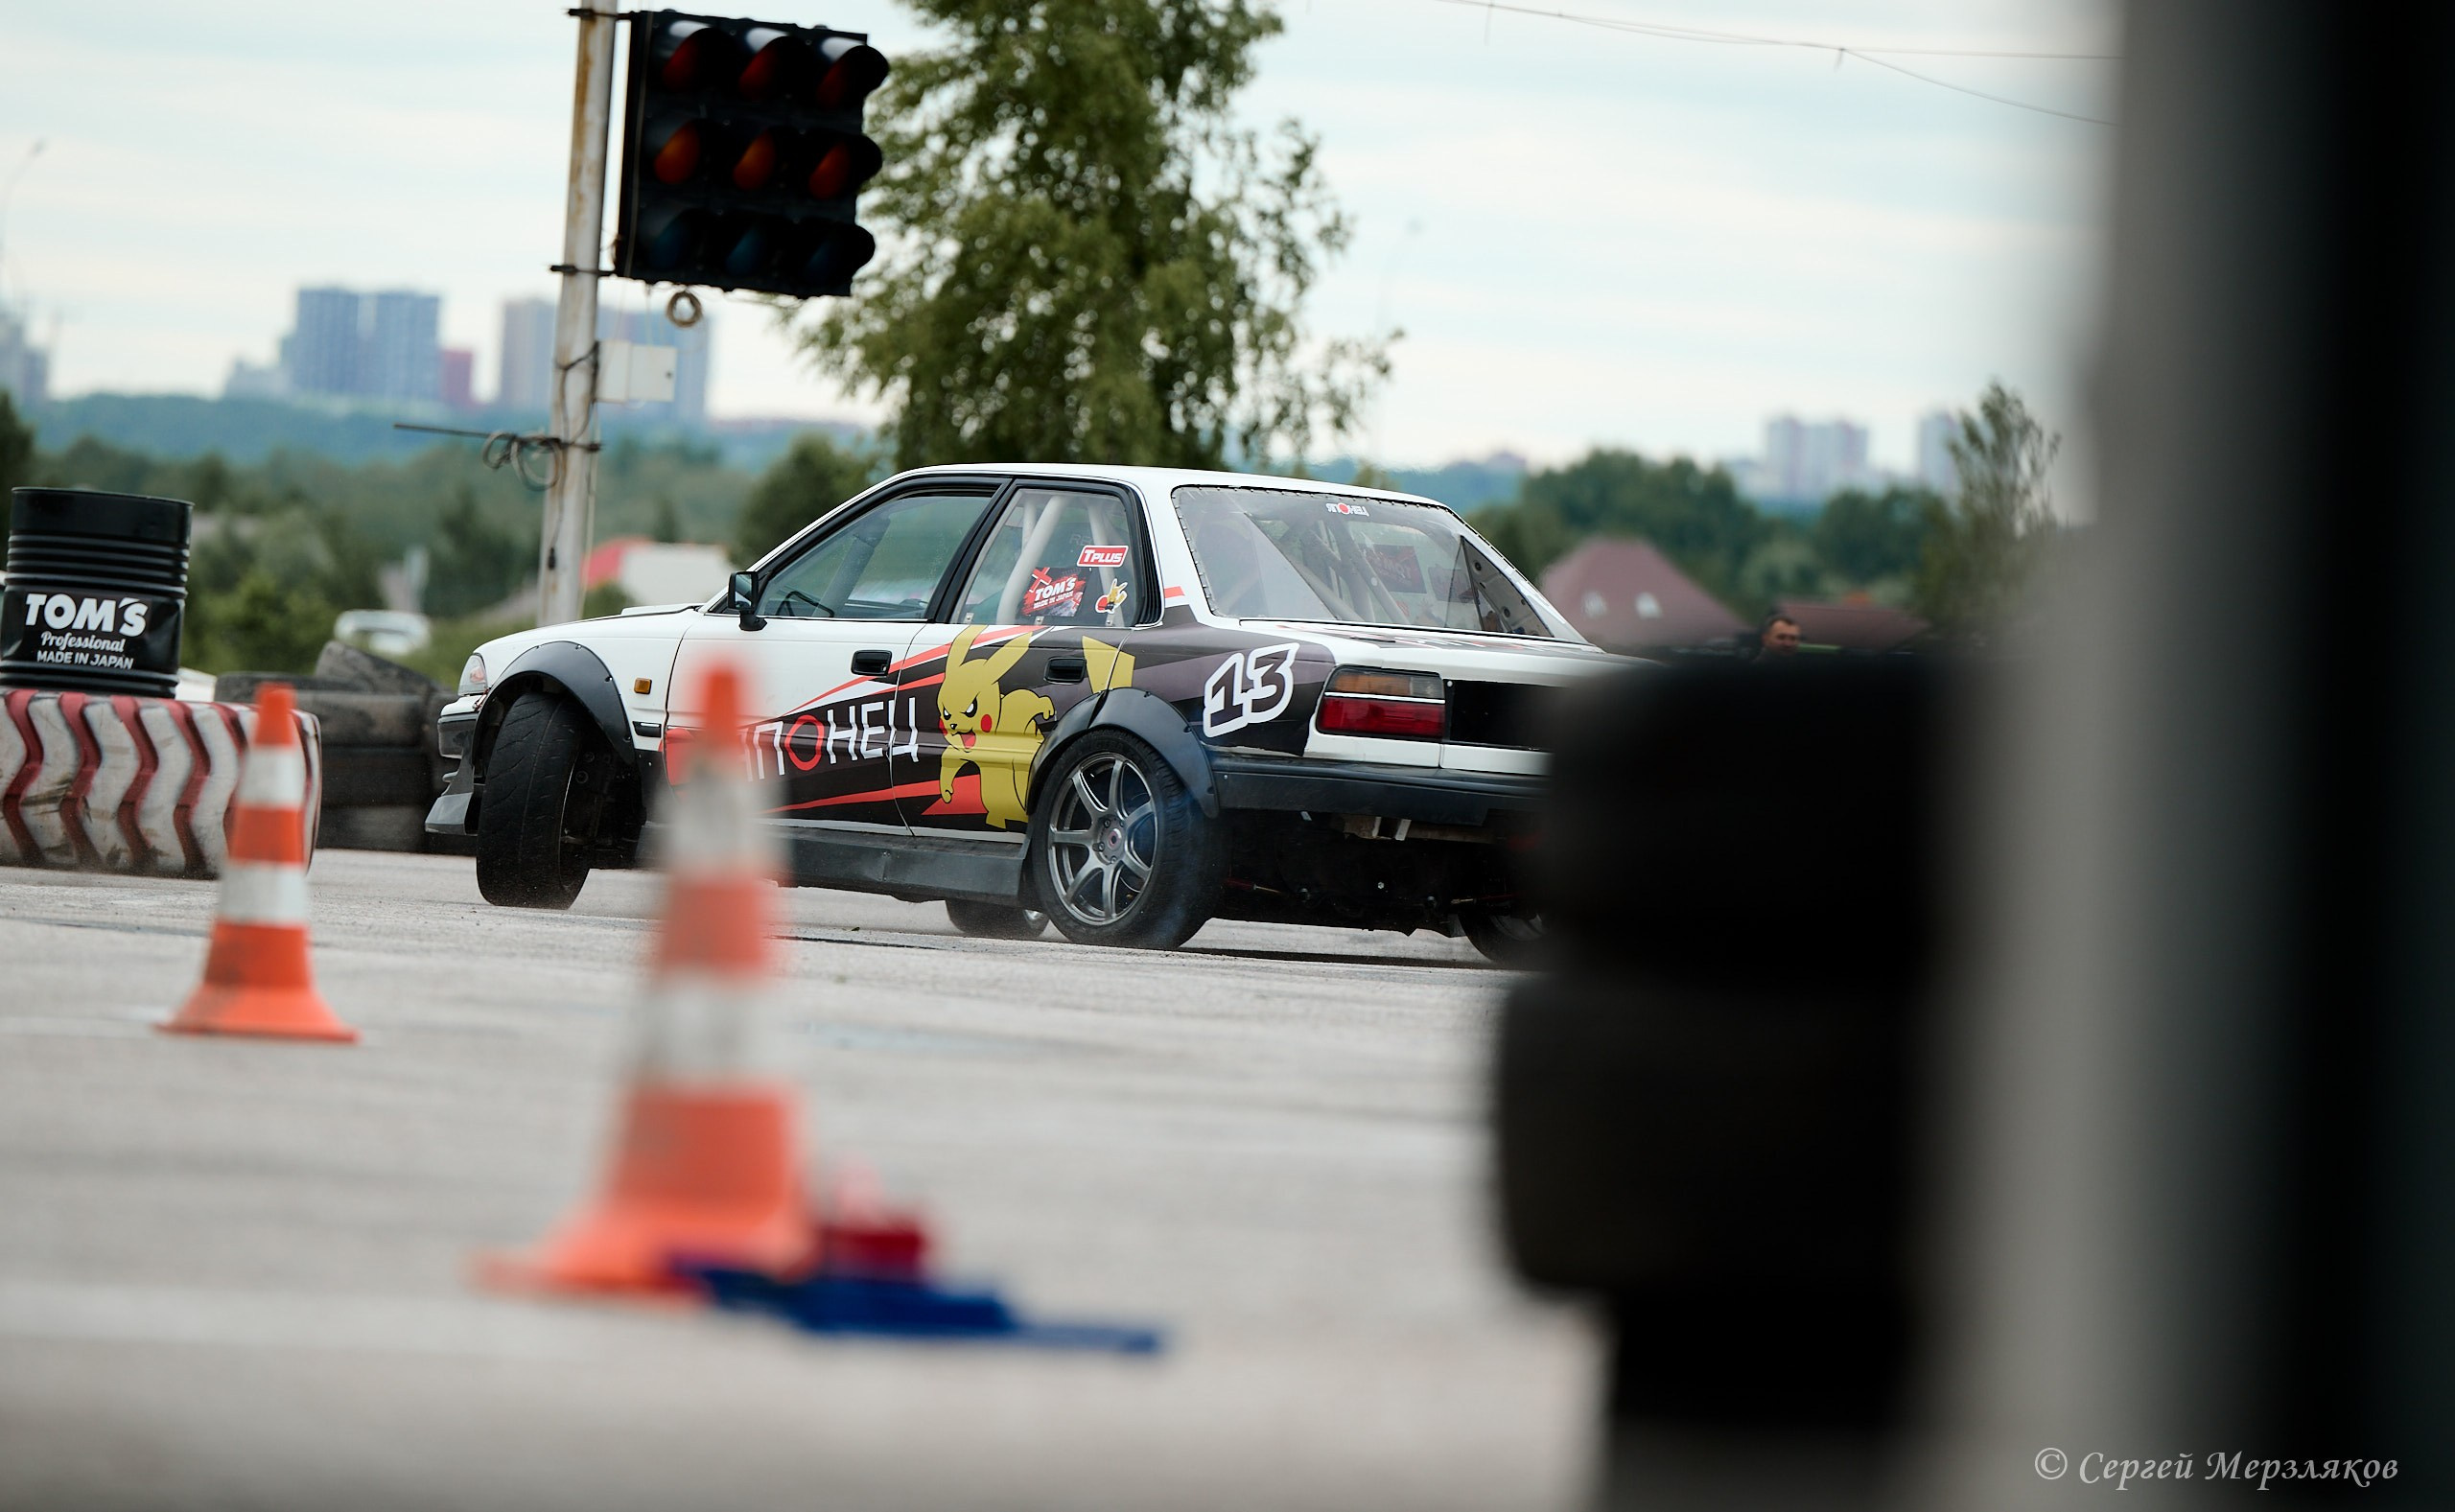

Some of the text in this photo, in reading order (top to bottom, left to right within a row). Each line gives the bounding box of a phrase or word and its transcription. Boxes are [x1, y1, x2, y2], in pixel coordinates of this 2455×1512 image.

[1084, 548, 1123, 563] TPLUS
[1035, 577, 1076, 601] TOM'S
[25, 593, 149, 638] TOM'S
[41, 631, 126, 653] Professional
[36, 650, 133, 669] MADE IN JAPAN
[1204, 642, 1300, 738] 13
